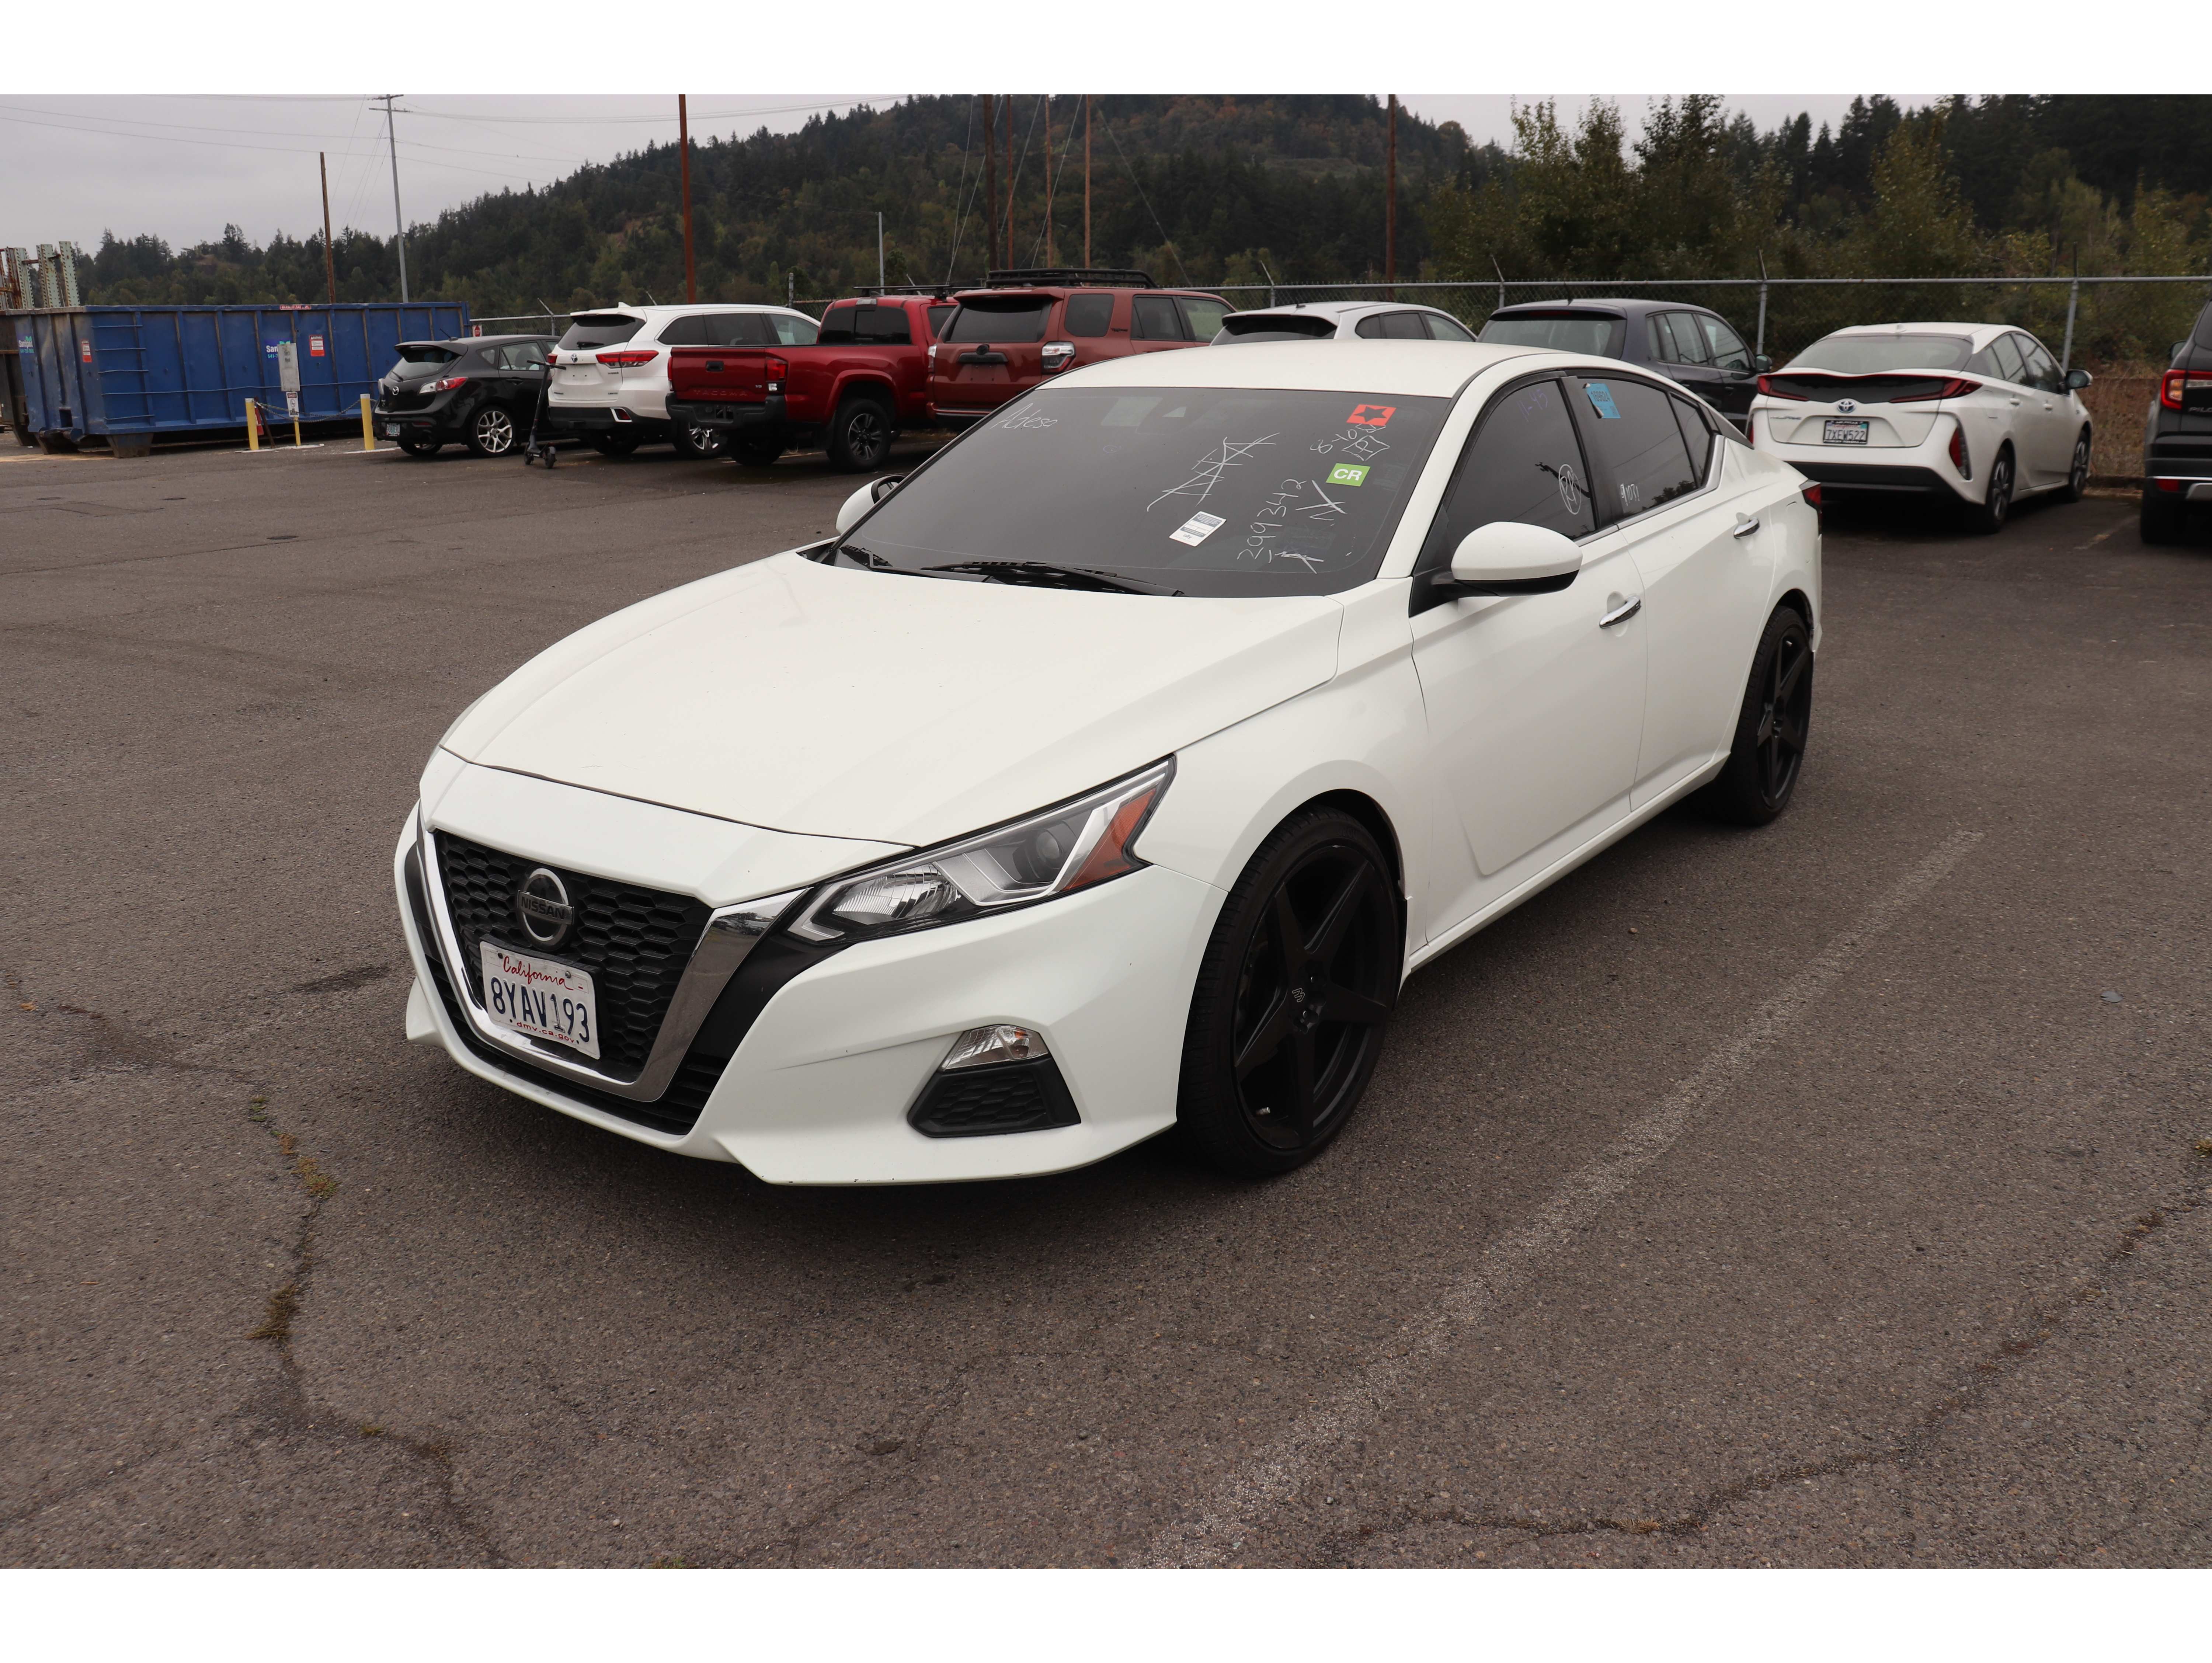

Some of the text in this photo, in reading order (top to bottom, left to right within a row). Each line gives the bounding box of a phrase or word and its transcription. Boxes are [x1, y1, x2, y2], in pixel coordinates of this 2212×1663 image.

[1334, 469, 1362, 481] CR
[521, 896, 565, 919] NISSAN
[503, 956, 574, 991] California
[491, 977, 589, 1043] 8YAV193
[517, 1022, 574, 1043] dmv.ca.gov
